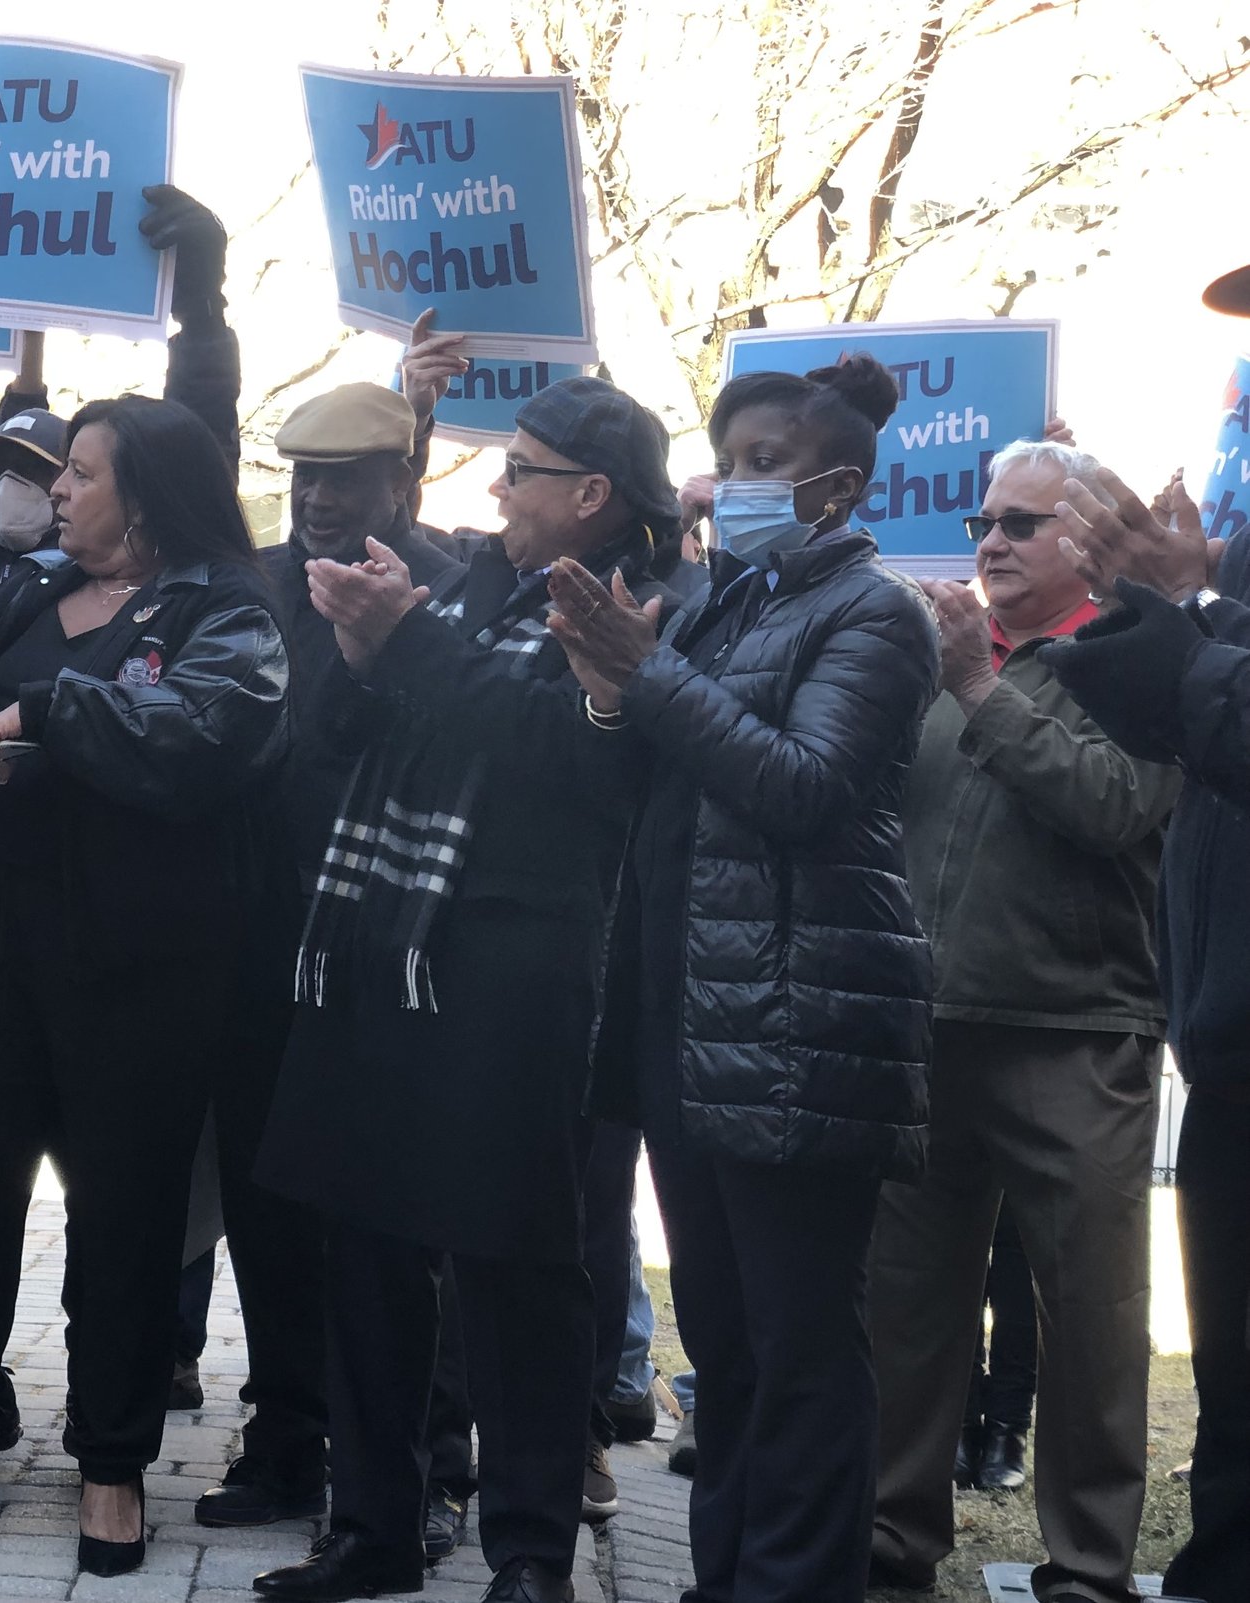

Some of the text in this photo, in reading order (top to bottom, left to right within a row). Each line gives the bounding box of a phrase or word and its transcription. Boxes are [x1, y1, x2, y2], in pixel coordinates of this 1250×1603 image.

[9, 140, 110, 179] with
[395, 118, 475, 166] ATU
[431, 175, 516, 219] with
[349, 222, 538, 294] Hochul
[444, 357, 549, 399] chul
[888, 356, 954, 401] TU
[897, 407, 989, 450] with
[854, 450, 995, 523] chul
